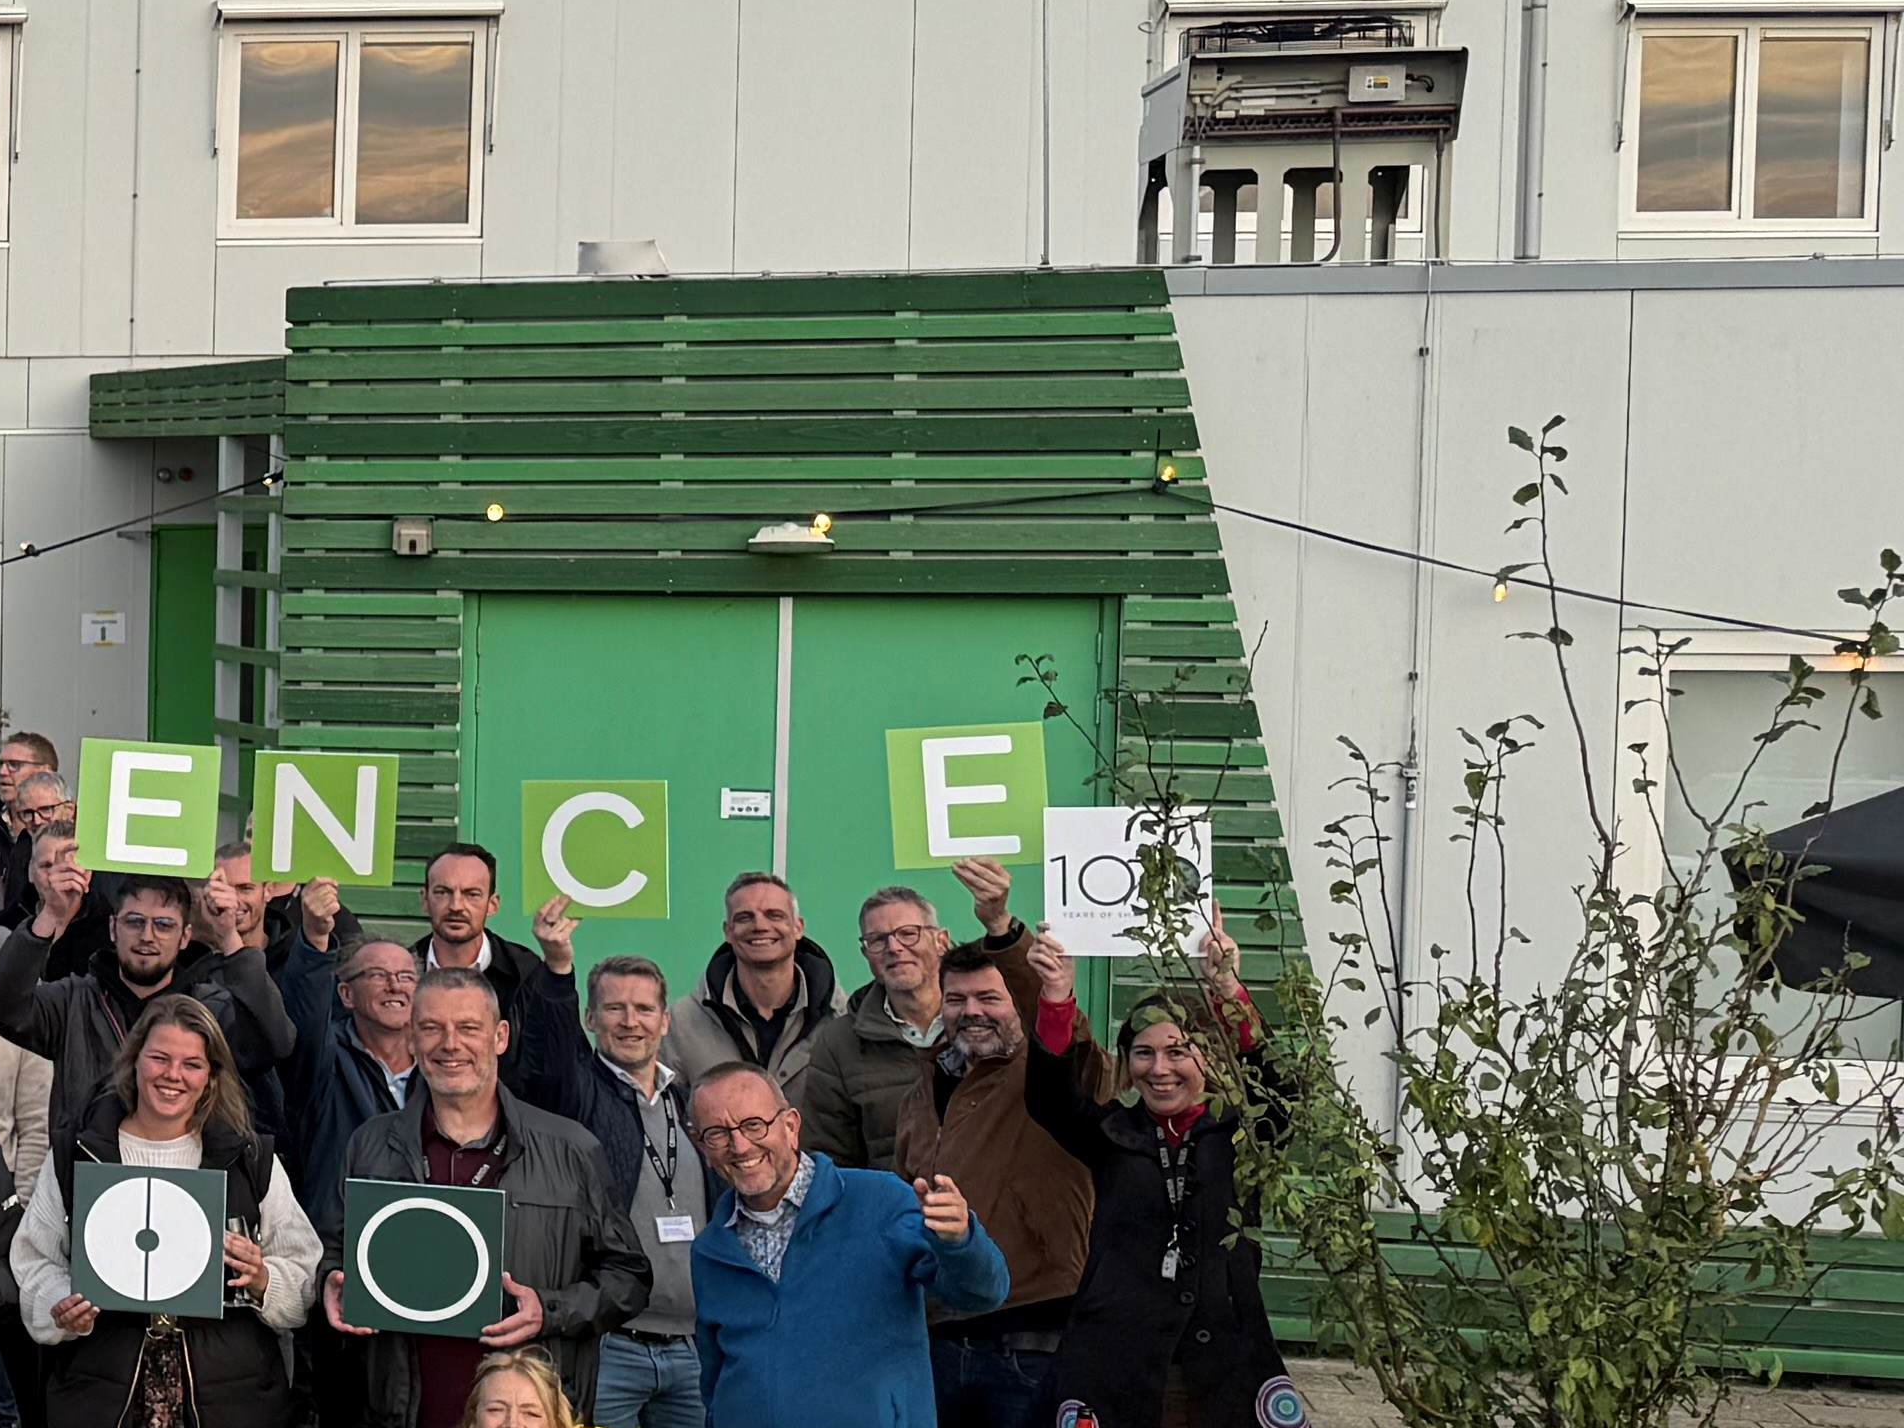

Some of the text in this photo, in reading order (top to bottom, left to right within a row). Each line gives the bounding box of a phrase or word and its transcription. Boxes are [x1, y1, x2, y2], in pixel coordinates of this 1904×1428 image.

[105, 750, 193, 867] E
[271, 763, 379, 876] N
[541, 791, 648, 908] C
[921, 734, 1022, 858] E
[1063, 911, 1096, 919] YEARS
